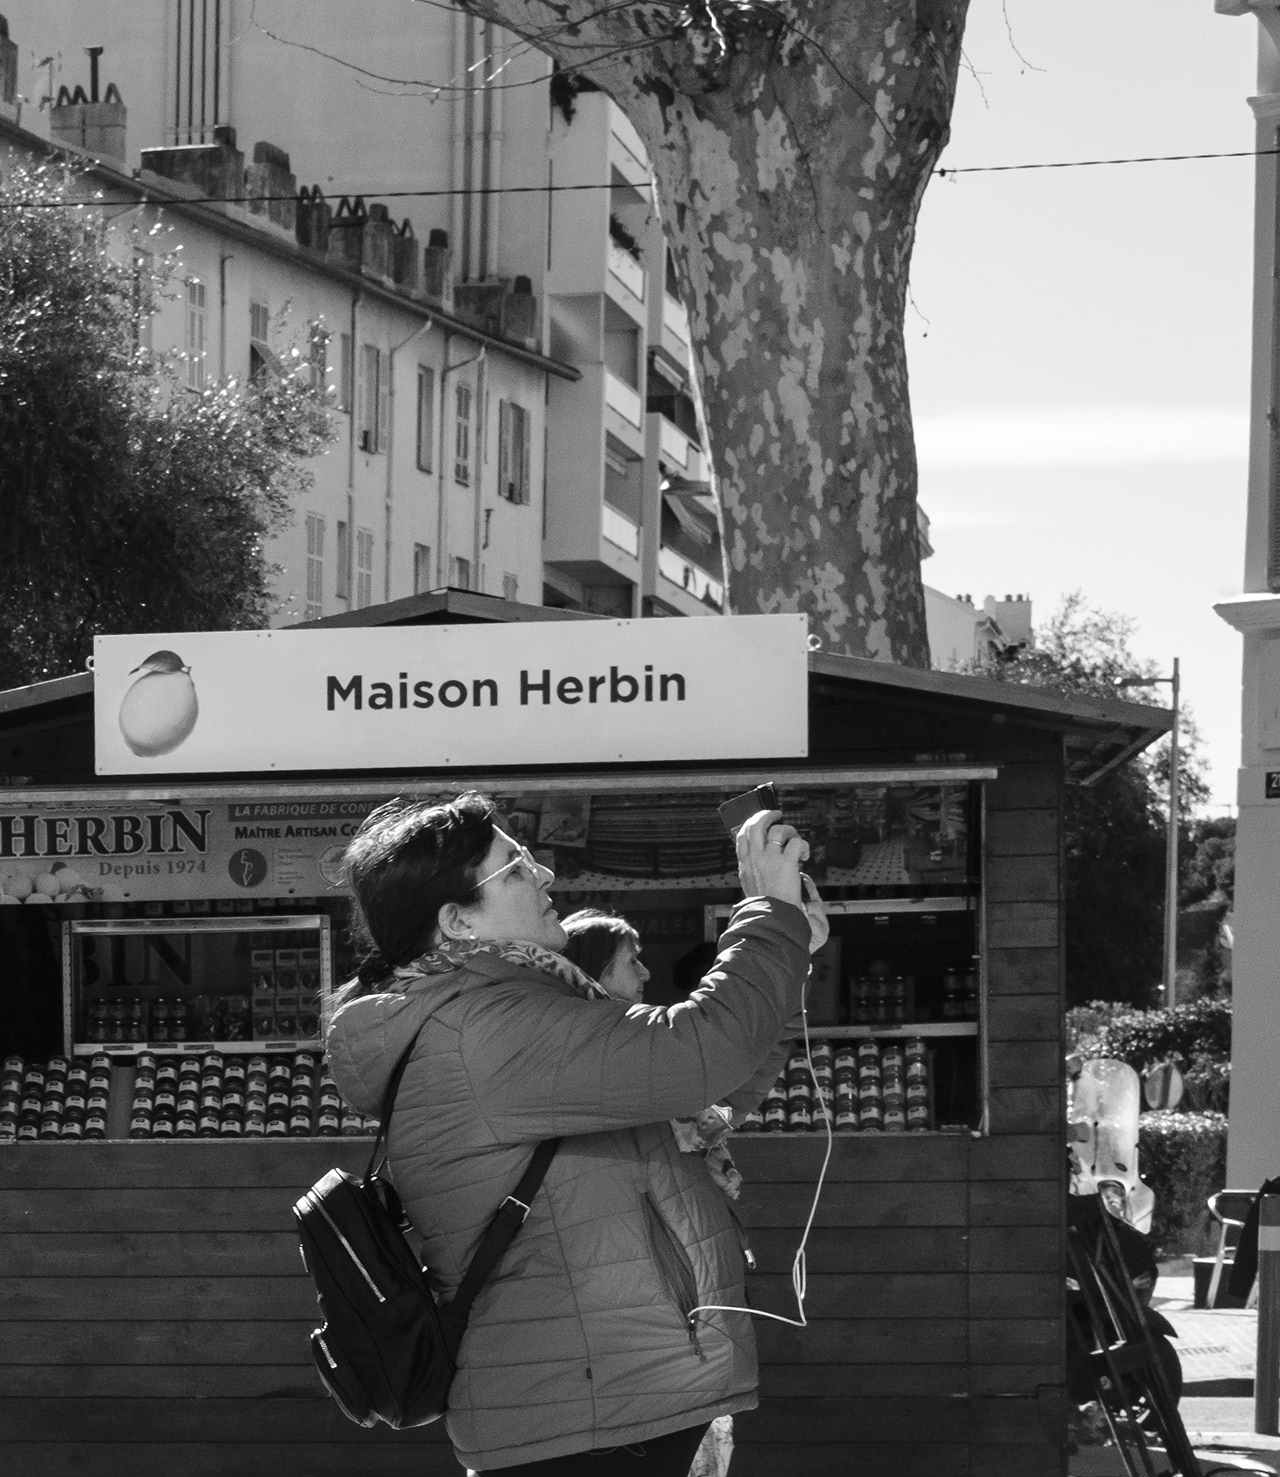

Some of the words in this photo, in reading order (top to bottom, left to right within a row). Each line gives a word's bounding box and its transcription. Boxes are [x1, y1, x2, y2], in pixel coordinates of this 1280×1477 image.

[326, 675, 499, 712] Maison
[519, 666, 687, 706] Herbin
[234, 806, 251, 816] LA
[253, 803, 317, 816] FABRIQUE
[319, 803, 338, 815] DE
[99, 860, 161, 879] Depuis
[167, 860, 207, 875] 1974
